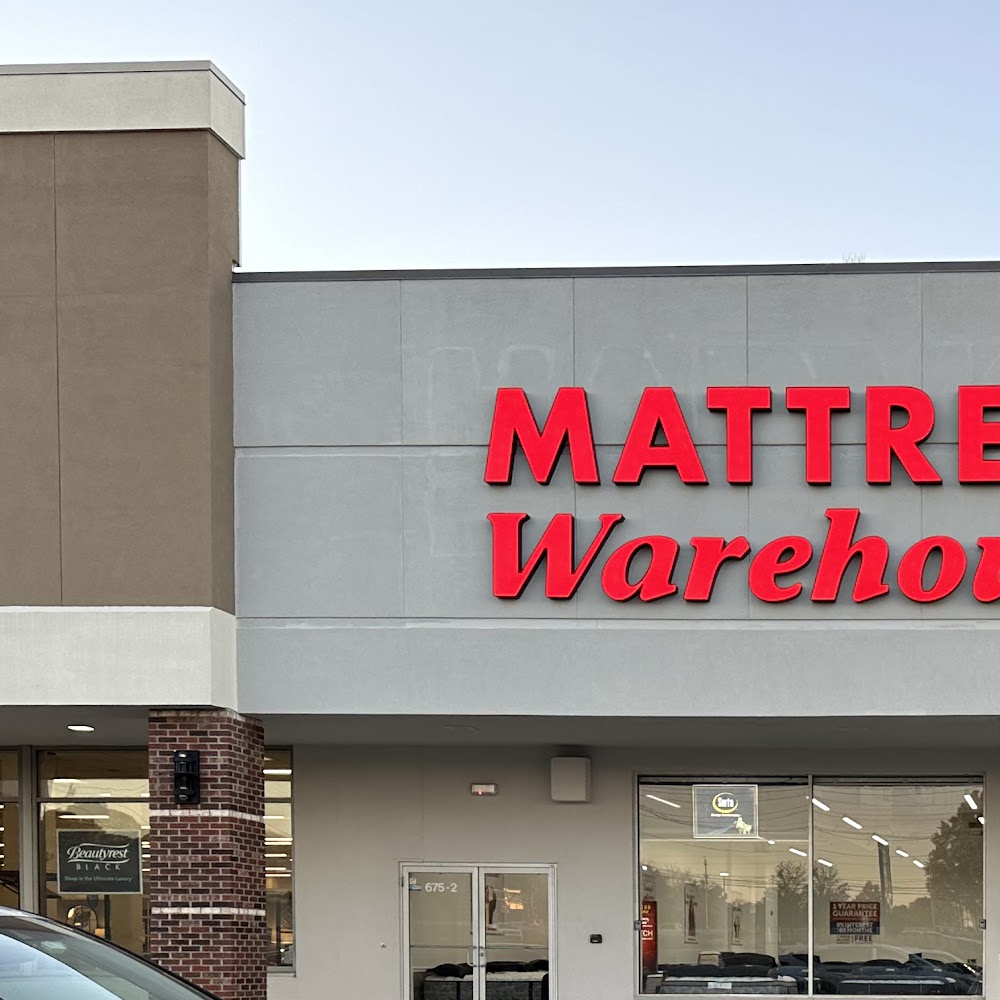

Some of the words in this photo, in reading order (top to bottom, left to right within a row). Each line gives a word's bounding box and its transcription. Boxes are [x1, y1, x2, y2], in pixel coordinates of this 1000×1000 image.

[66, 846, 129, 861] Beautyrest
[76, 863, 121, 871] BLACK
[425, 882, 458, 893] 675-2
